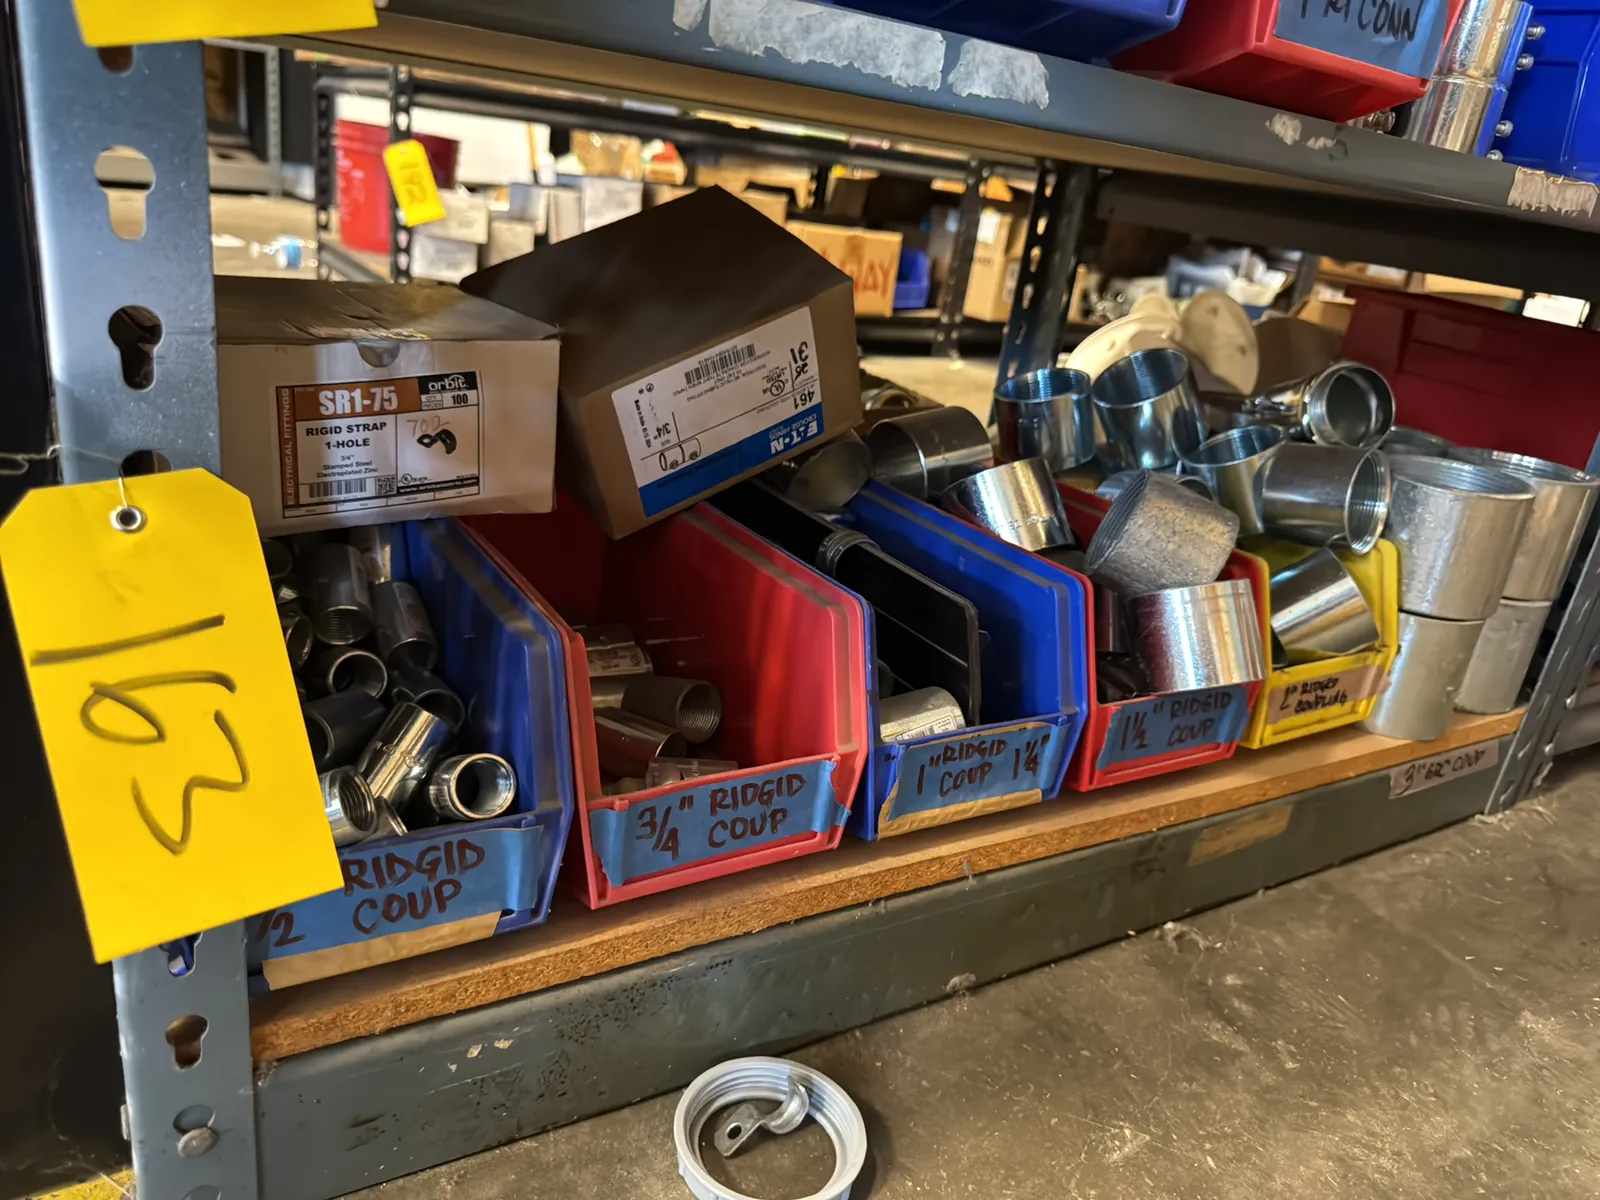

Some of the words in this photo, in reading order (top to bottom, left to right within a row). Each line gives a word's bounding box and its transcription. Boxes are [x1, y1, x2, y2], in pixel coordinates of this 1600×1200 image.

[428, 375, 468, 391] orbit
[282, 388, 293, 438] FITTINGS
[319, 386, 398, 416] SR1-75
[451, 393, 468, 405] 100
[792, 390, 815, 410] 461
[305, 426, 342, 437] RIGID
[346, 422, 388, 434] STRAP
[325, 437, 370, 450] 1-HOLE
[653, 422, 671, 440] 3/4"
[316, 469, 363, 479] Electroplated
[323, 462, 354, 472] Stamped
[355, 460, 373, 468] Steel
[1170, 691, 1233, 721] RIDGID
[30, 613, 250, 857] 193
[1167, 717, 1215, 747] COUP
[943, 738, 1008, 762] RIDGID
[940, 762, 993, 797] COUP
[709, 773, 806, 817] RIDGID
[708, 806, 788, 848] COUP
[343, 838, 485, 896] RIDGID
[352, 878, 462, 935] COUP
